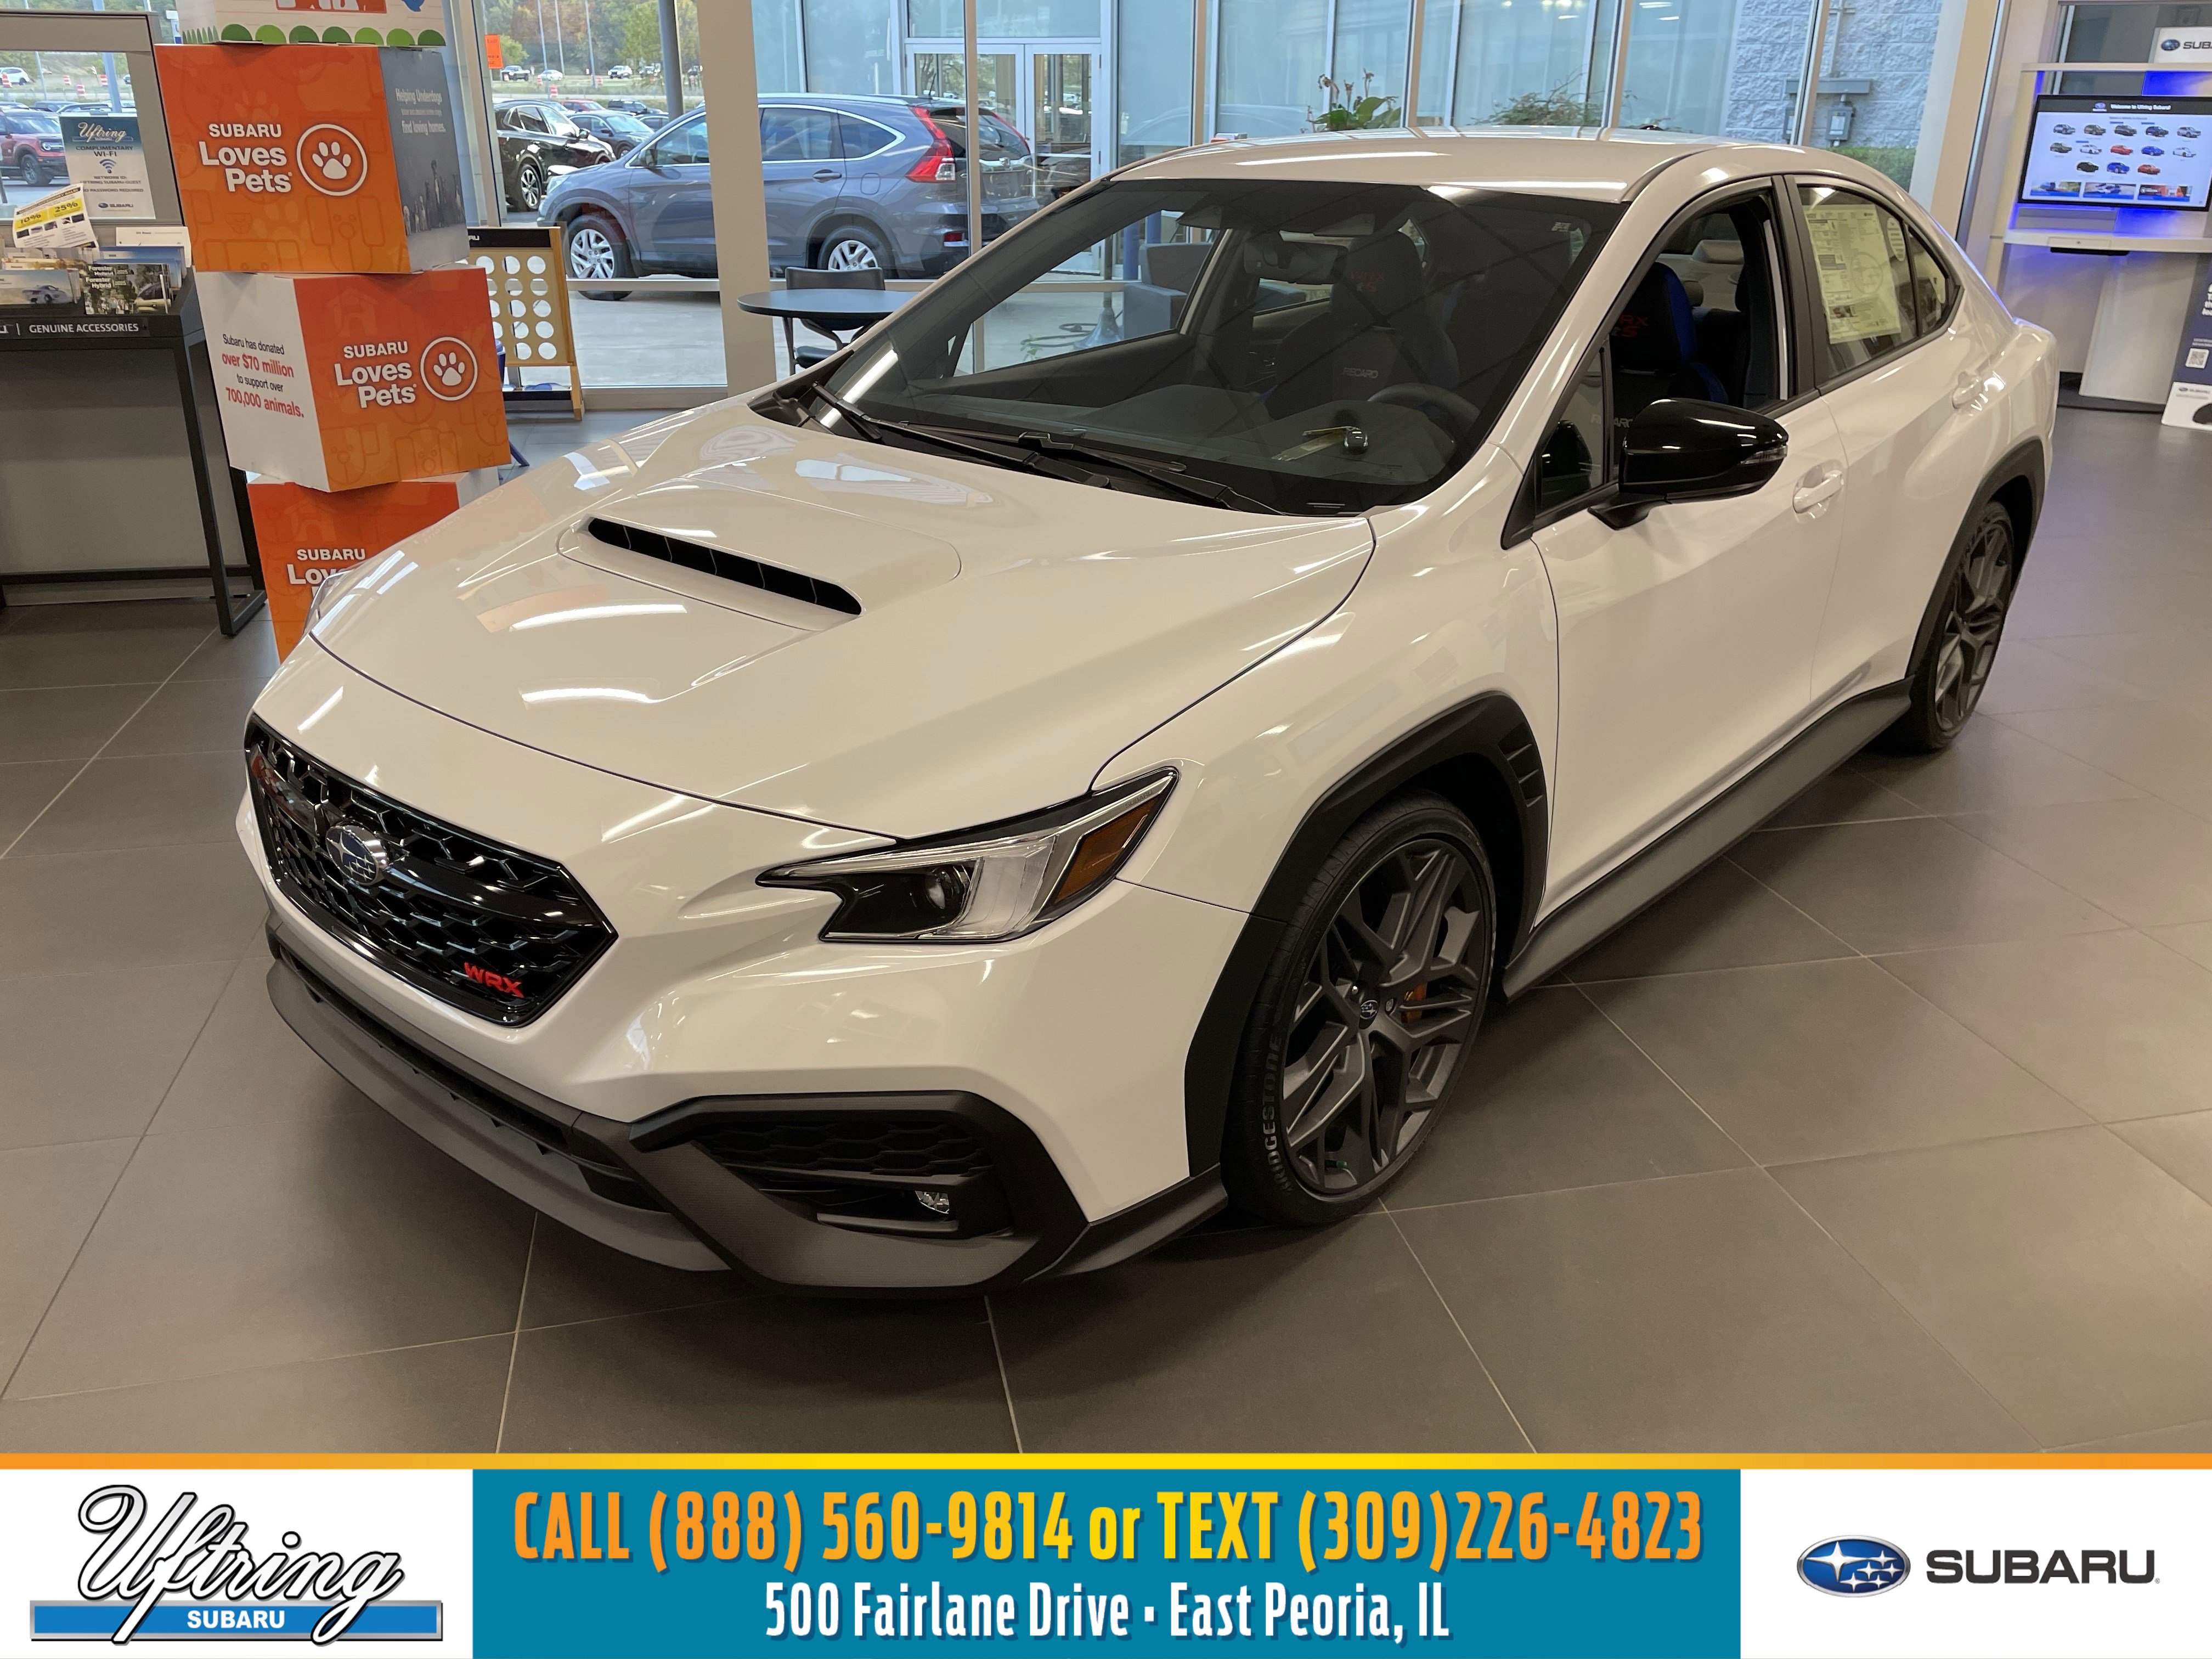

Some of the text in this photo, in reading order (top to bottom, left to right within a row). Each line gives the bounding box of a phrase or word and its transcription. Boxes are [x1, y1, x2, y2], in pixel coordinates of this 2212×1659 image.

[78, 122, 126, 143] Uftring
[208, 123, 282, 138] SUBARU
[199, 141, 287, 166] Loves
[225, 168, 292, 193] Pets
[55, 201, 78, 213] 25%
[21, 213, 41, 224] 10%
[29, 323, 139, 333] GENUINE ACCESSORIES
[222, 334, 285, 355] Subaru has donated
[343, 341, 408, 359] SUBARU
[222, 352, 294, 378] over $70 million
[334, 362, 412, 386] Loves
[236, 373, 284, 392] to support over
[225, 387, 304, 418] 700,000 animals.
[358, 383, 416, 409] Pets
[297, 549, 366, 561] SUBARU
[464, 961, 524, 998] WRX
